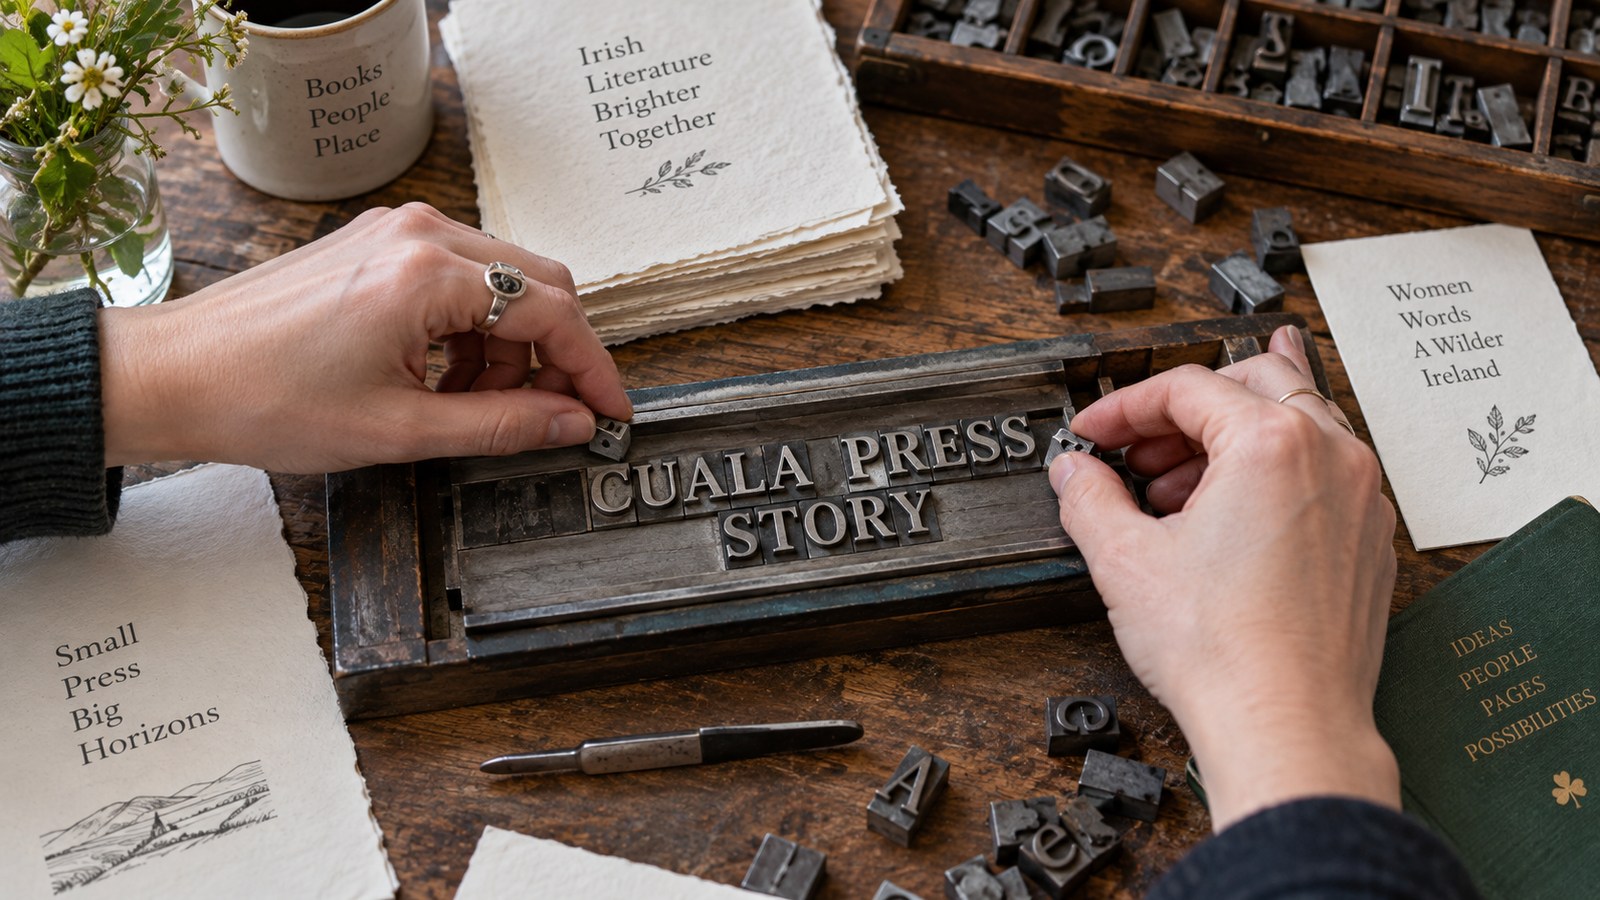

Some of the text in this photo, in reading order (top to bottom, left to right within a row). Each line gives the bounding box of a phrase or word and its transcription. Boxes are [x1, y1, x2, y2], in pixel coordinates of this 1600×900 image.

[578, 35, 645, 66] Irish
[304, 64, 383, 99] Books
[585, 52, 713, 94] Literature
[309, 90, 391, 128] People
[592, 84, 700, 123] Brighter
[313, 128, 381, 158] Place
[599, 111, 716, 150] Together
[1386, 280, 1473, 302] Women
[1398, 305, 1471, 329] Words
[1414, 331, 1504, 359] A Wilder
[1420, 359, 1502, 388] Ireland
[591, 416, 1036, 513] CUALA PRESS
[723, 489, 931, 558] STORY
[55, 622, 139, 668] Small
[1450, 619, 1513, 658] IDEAS
[61, 662, 141, 700] Press
[1458, 643, 1538, 690] PEOPLE
[1480, 675, 1546, 717] PAGES
[69, 702, 123, 733] Big
[77, 706, 220, 766] Horizons
[1464, 688, 1597, 762] POSSIBILITIES
[875, 755, 934, 816] A
[1032, 824, 1077, 869] e
